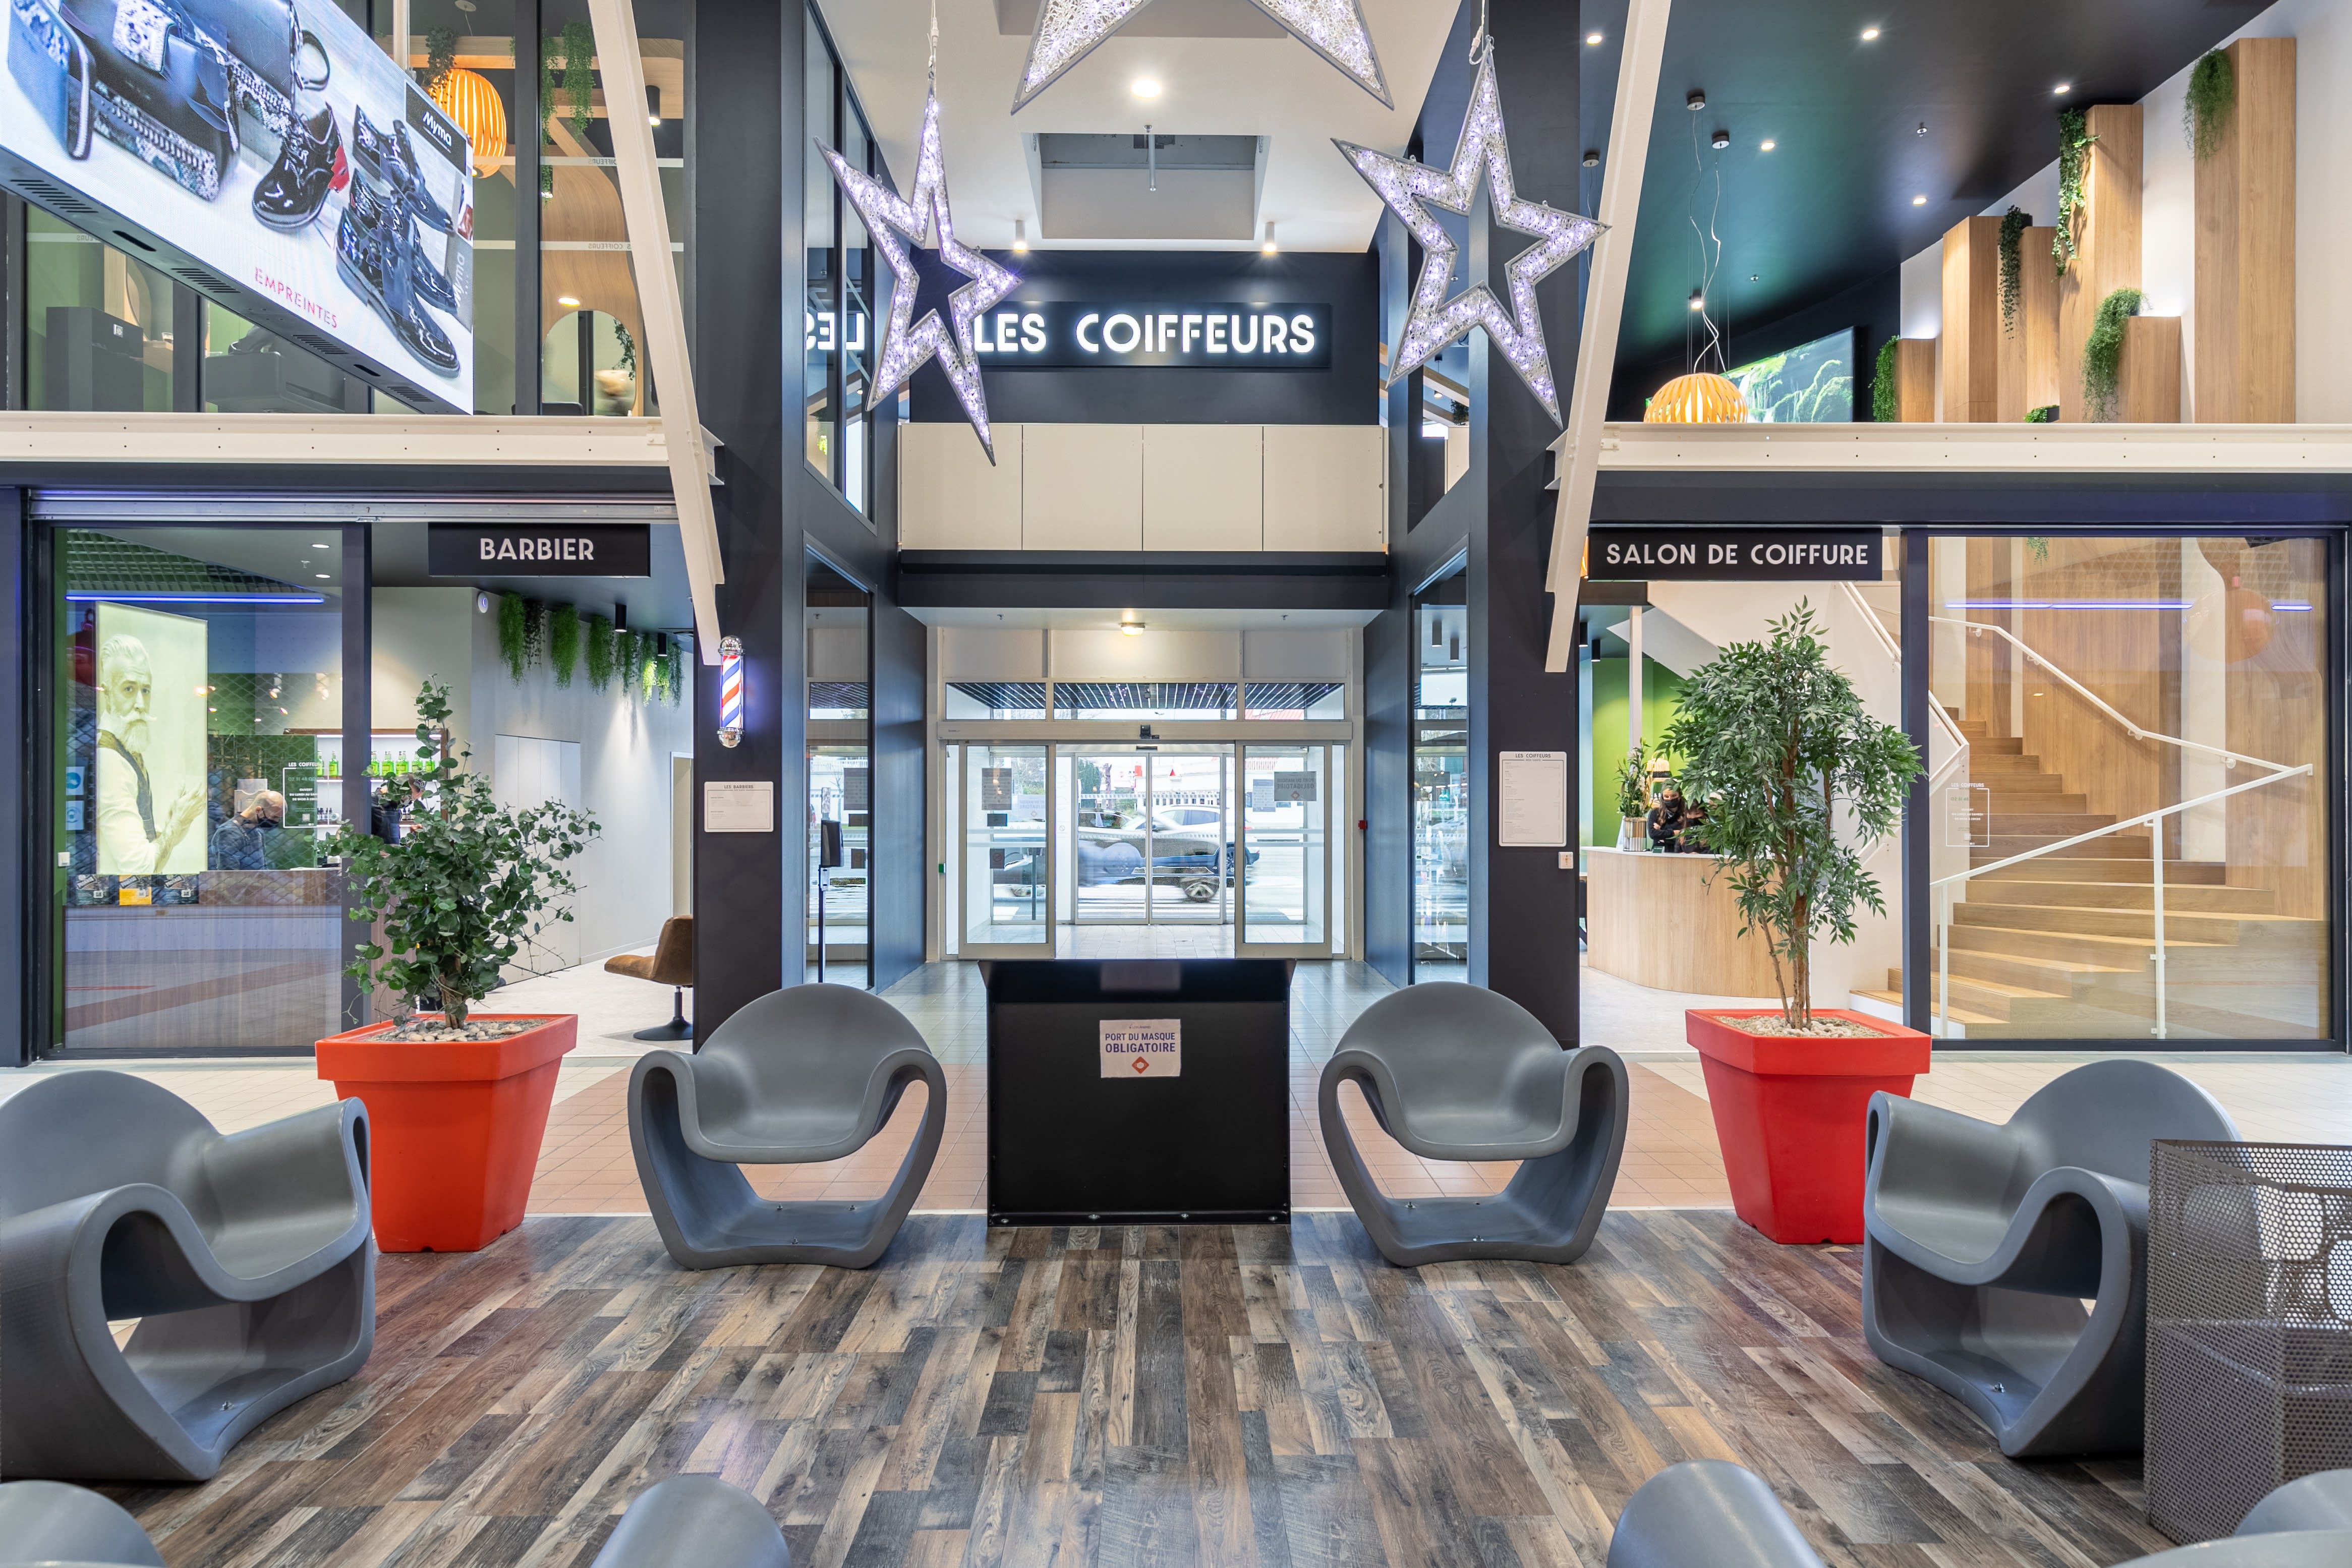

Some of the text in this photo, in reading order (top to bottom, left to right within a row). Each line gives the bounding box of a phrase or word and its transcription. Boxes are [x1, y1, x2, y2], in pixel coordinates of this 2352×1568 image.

[422, 111, 452, 147] Myma
[255, 267, 337, 328] EMPREINTES
[974, 313, 1315, 354] LES COIFFEURS
[480, 538, 594, 560] BARBIER
[1606, 544, 1868, 565] SALON DE COIFFURE
[1105, 1033, 1126, 1041] PORT
[1141, 1032, 1175, 1041] MASQUE
[1105, 1042, 1176, 1053] OBLIGATOIRE
